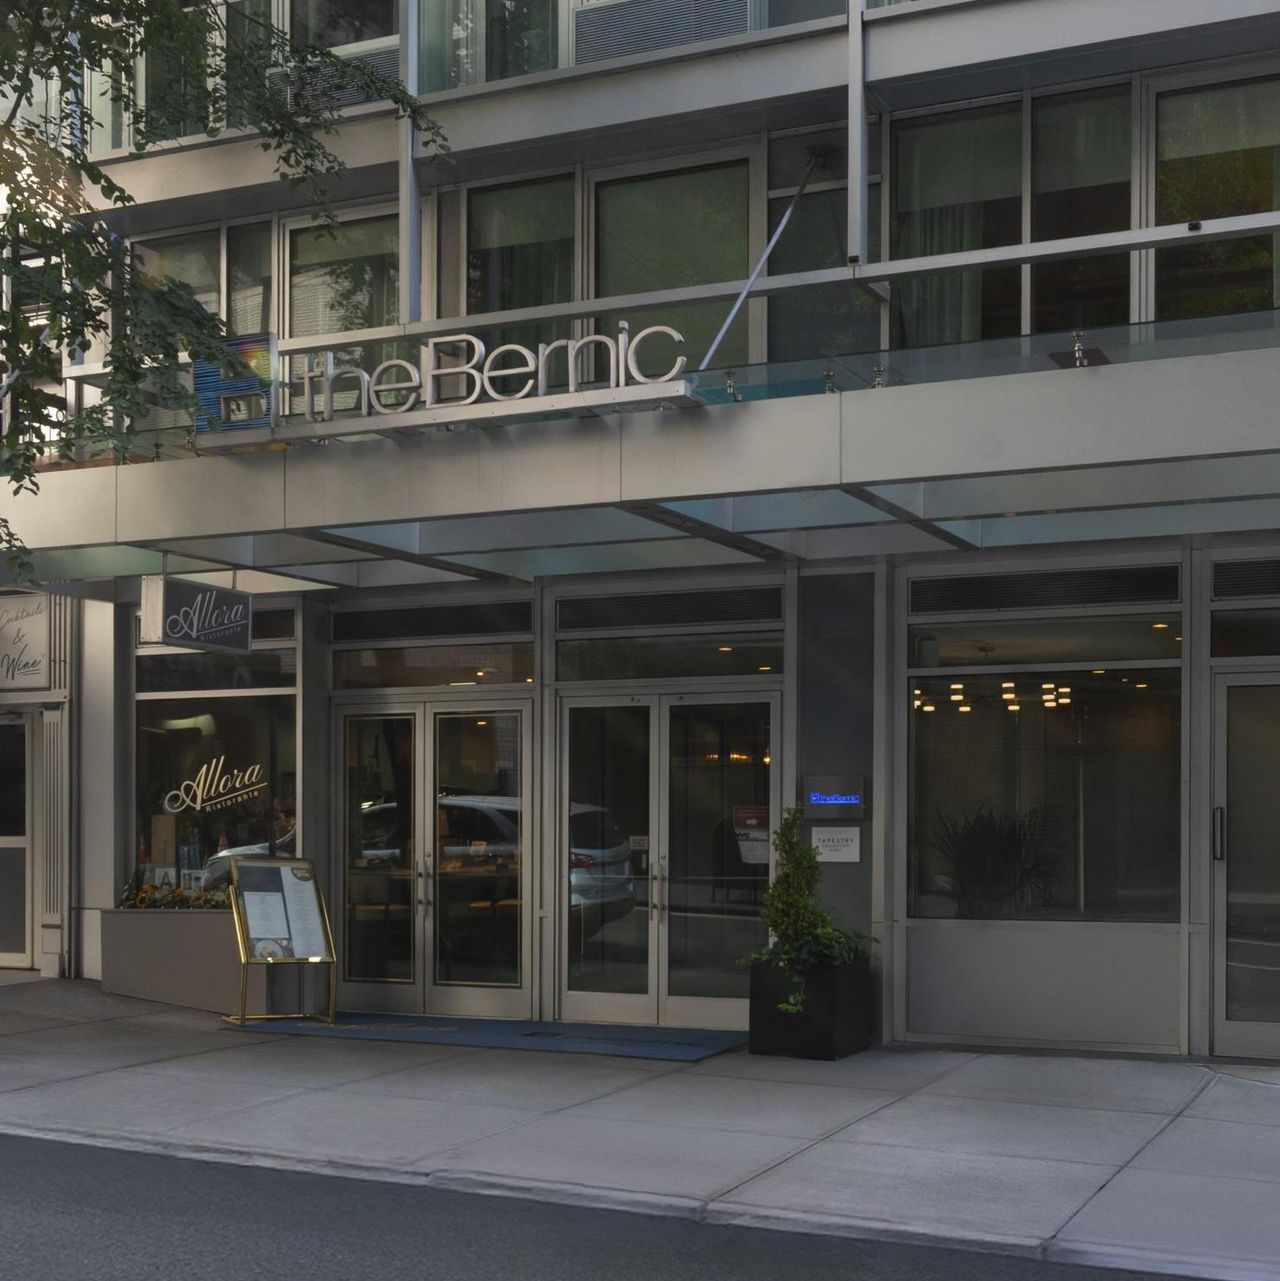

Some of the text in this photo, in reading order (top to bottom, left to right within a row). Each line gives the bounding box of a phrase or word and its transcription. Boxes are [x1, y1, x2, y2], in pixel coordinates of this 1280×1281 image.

[294, 321, 687, 421] theBernic
[166, 590, 245, 639] Allora
[165, 755, 265, 813] Allora
[205, 790, 259, 813] Ristorante
